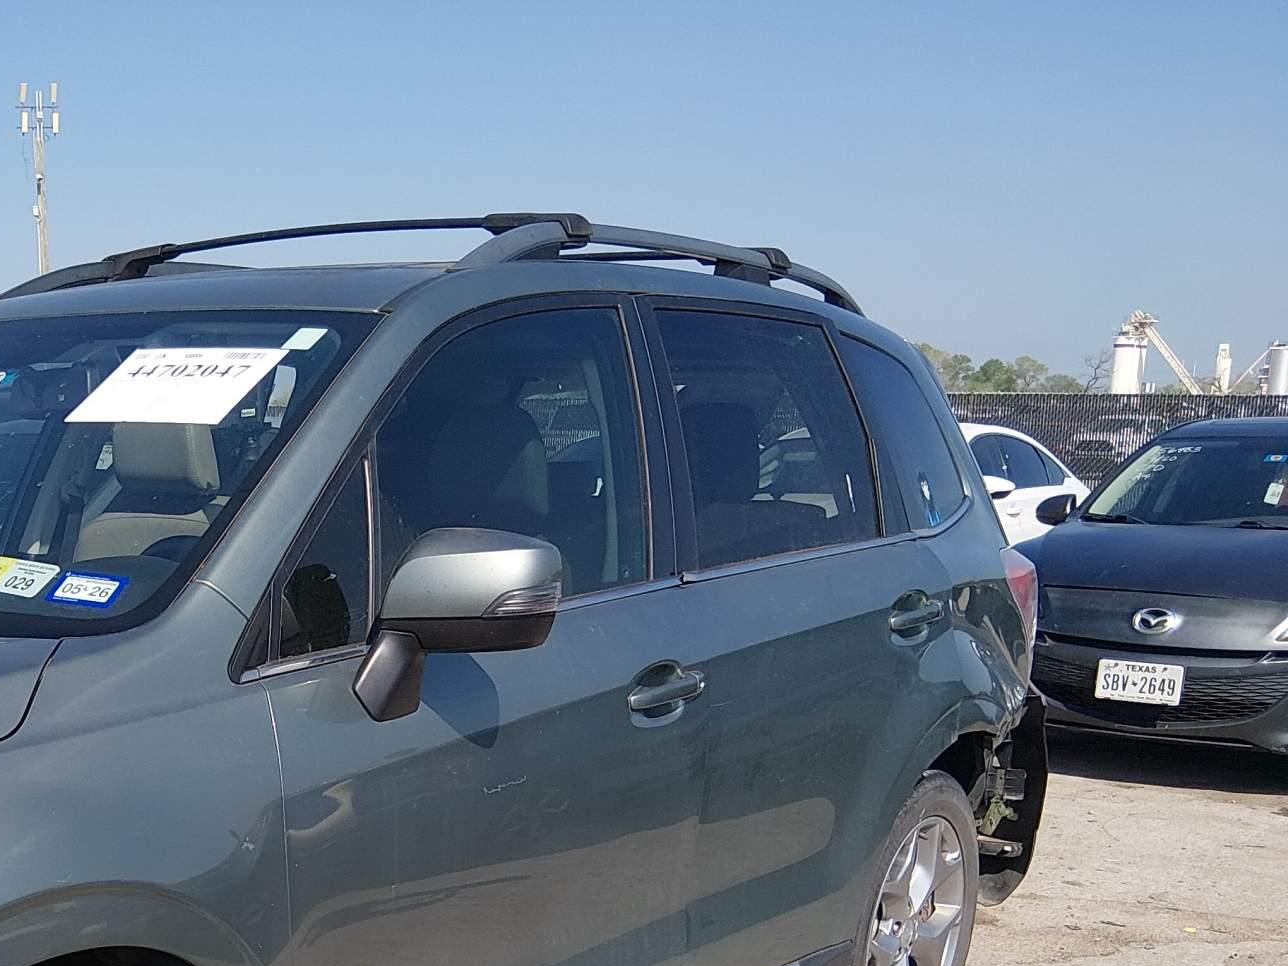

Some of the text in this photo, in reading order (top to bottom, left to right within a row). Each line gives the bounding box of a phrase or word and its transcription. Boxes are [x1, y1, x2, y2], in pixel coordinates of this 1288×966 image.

[128, 364, 252, 378] 44702047
[4, 575, 35, 591] 029
[1125, 664, 1158, 674] TEXAS
